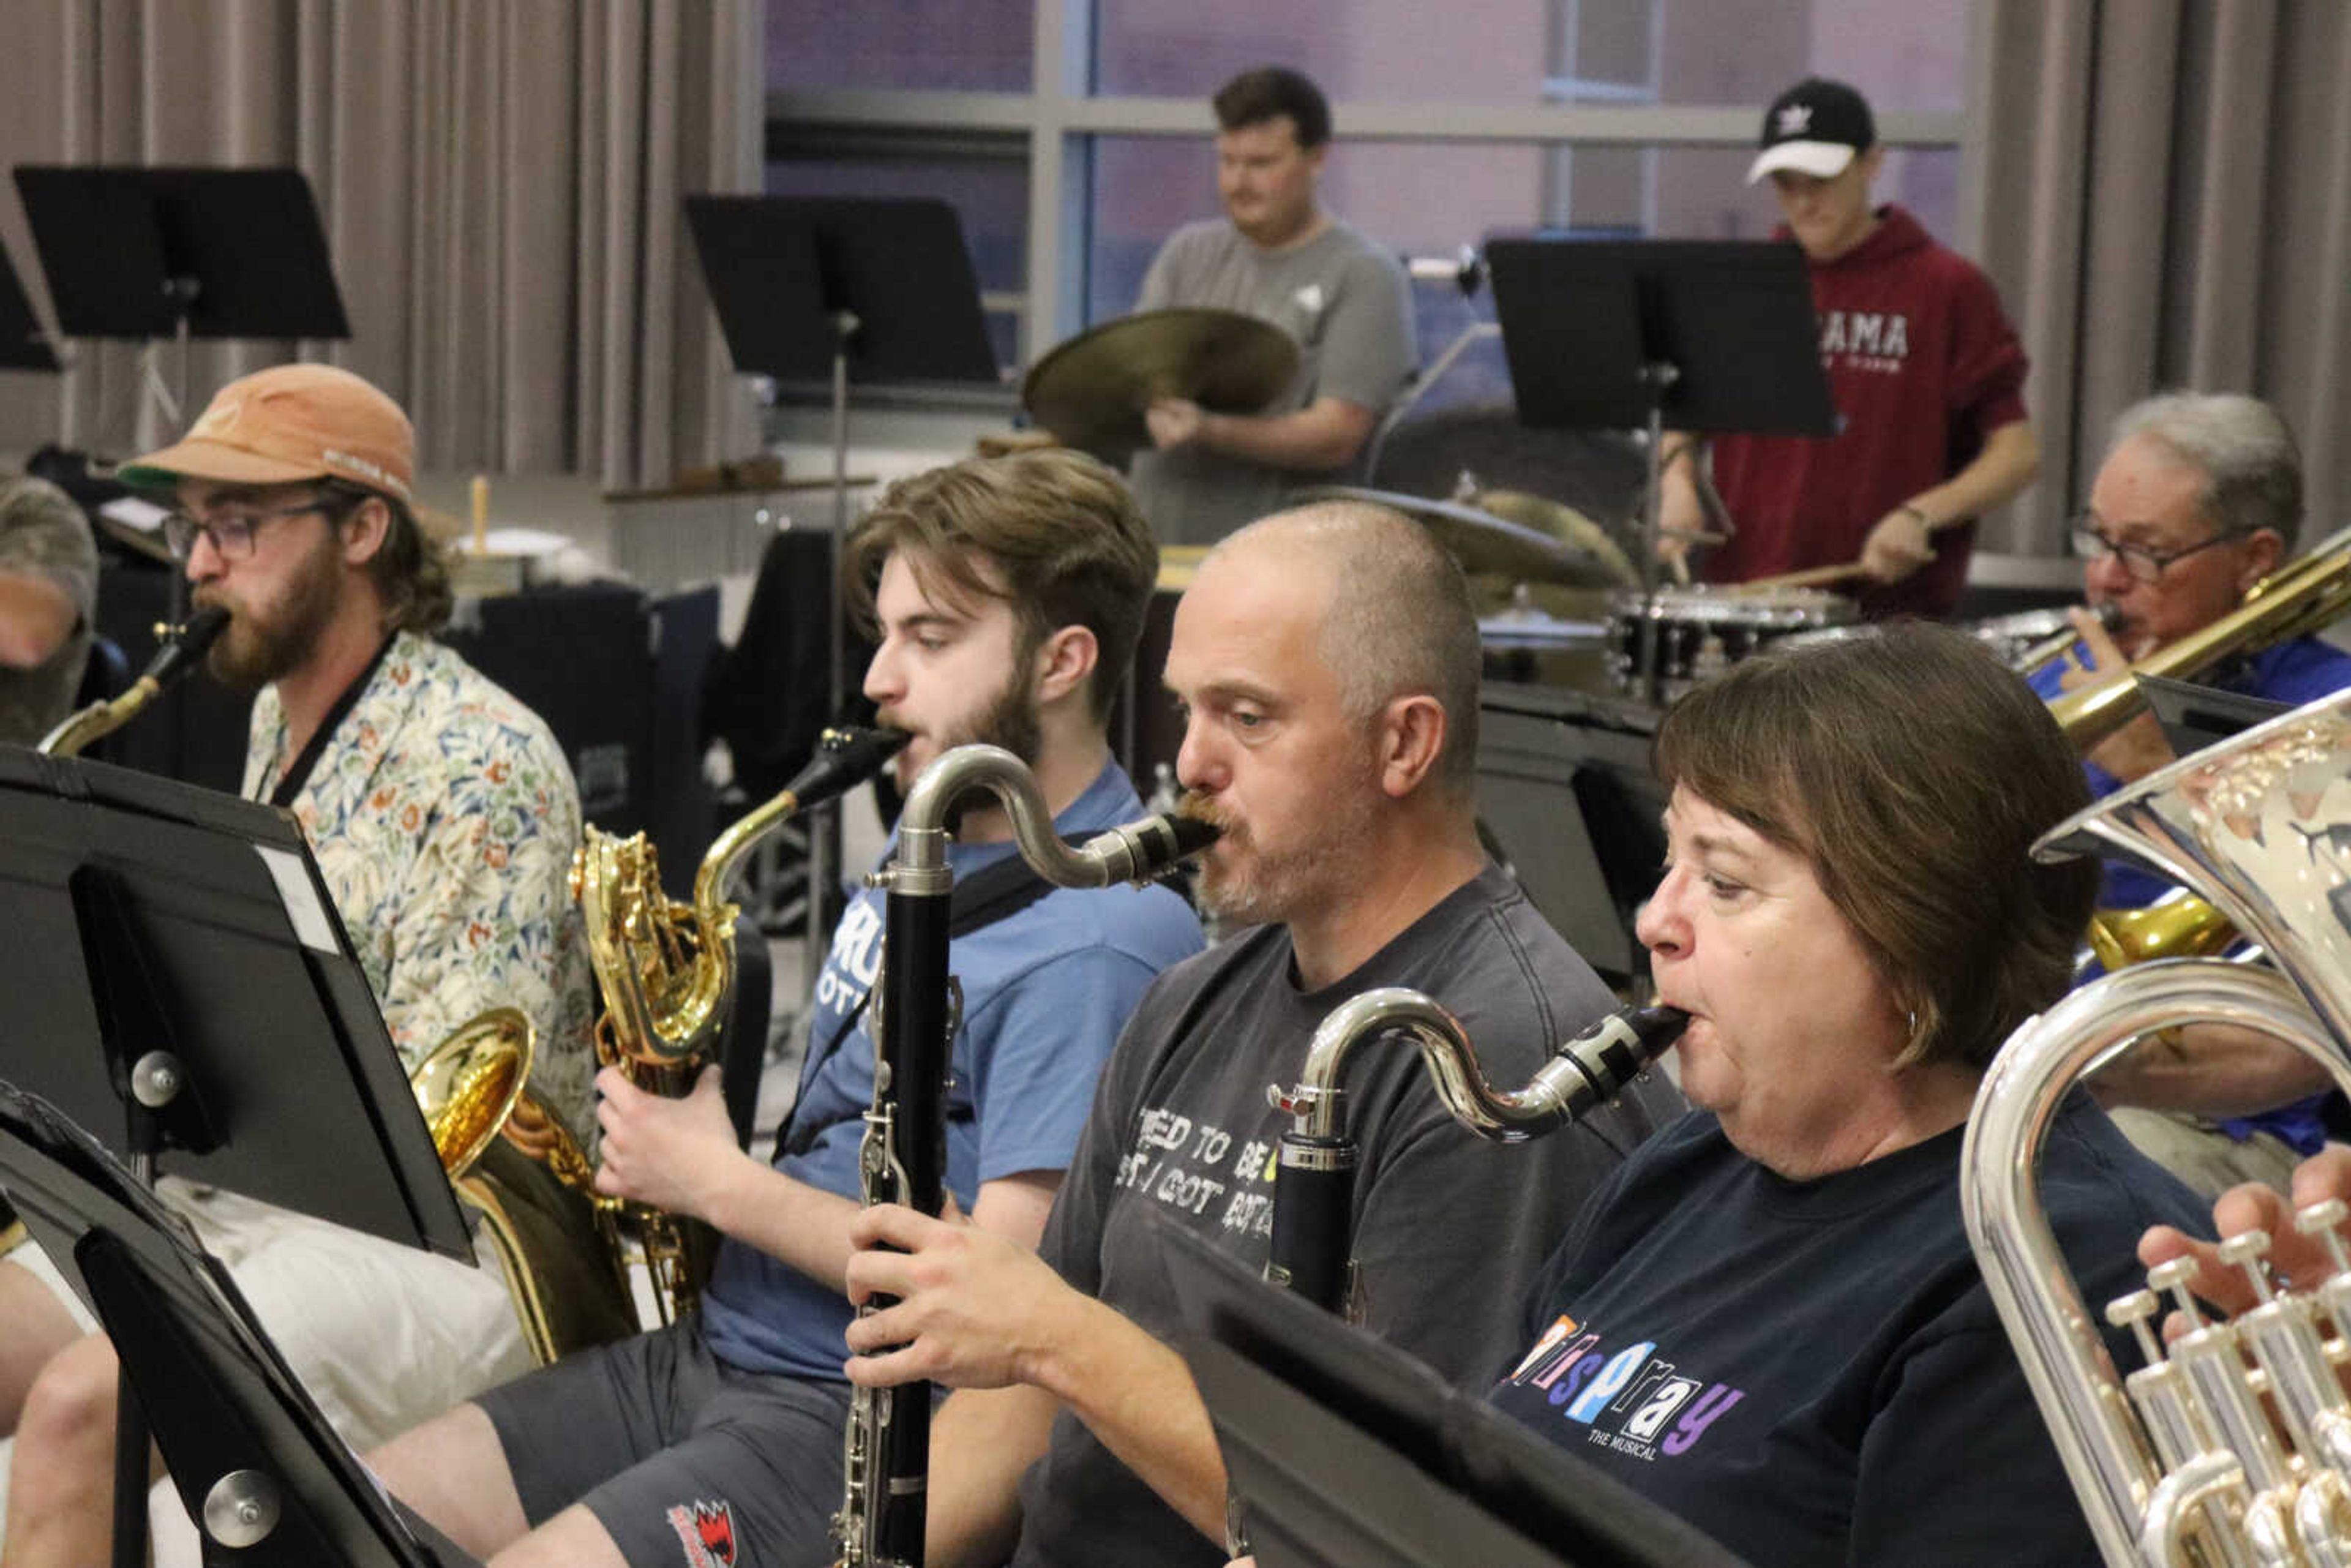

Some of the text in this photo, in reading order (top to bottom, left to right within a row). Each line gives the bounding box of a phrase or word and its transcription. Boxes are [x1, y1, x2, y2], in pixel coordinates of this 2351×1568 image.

[1816, 310, 1909, 357] AMA
[1191, 1125, 1232, 1165] TO
[1157, 1168, 1224, 1215] GOT
[1588, 1428, 1657, 1461] THE MUSICAL
